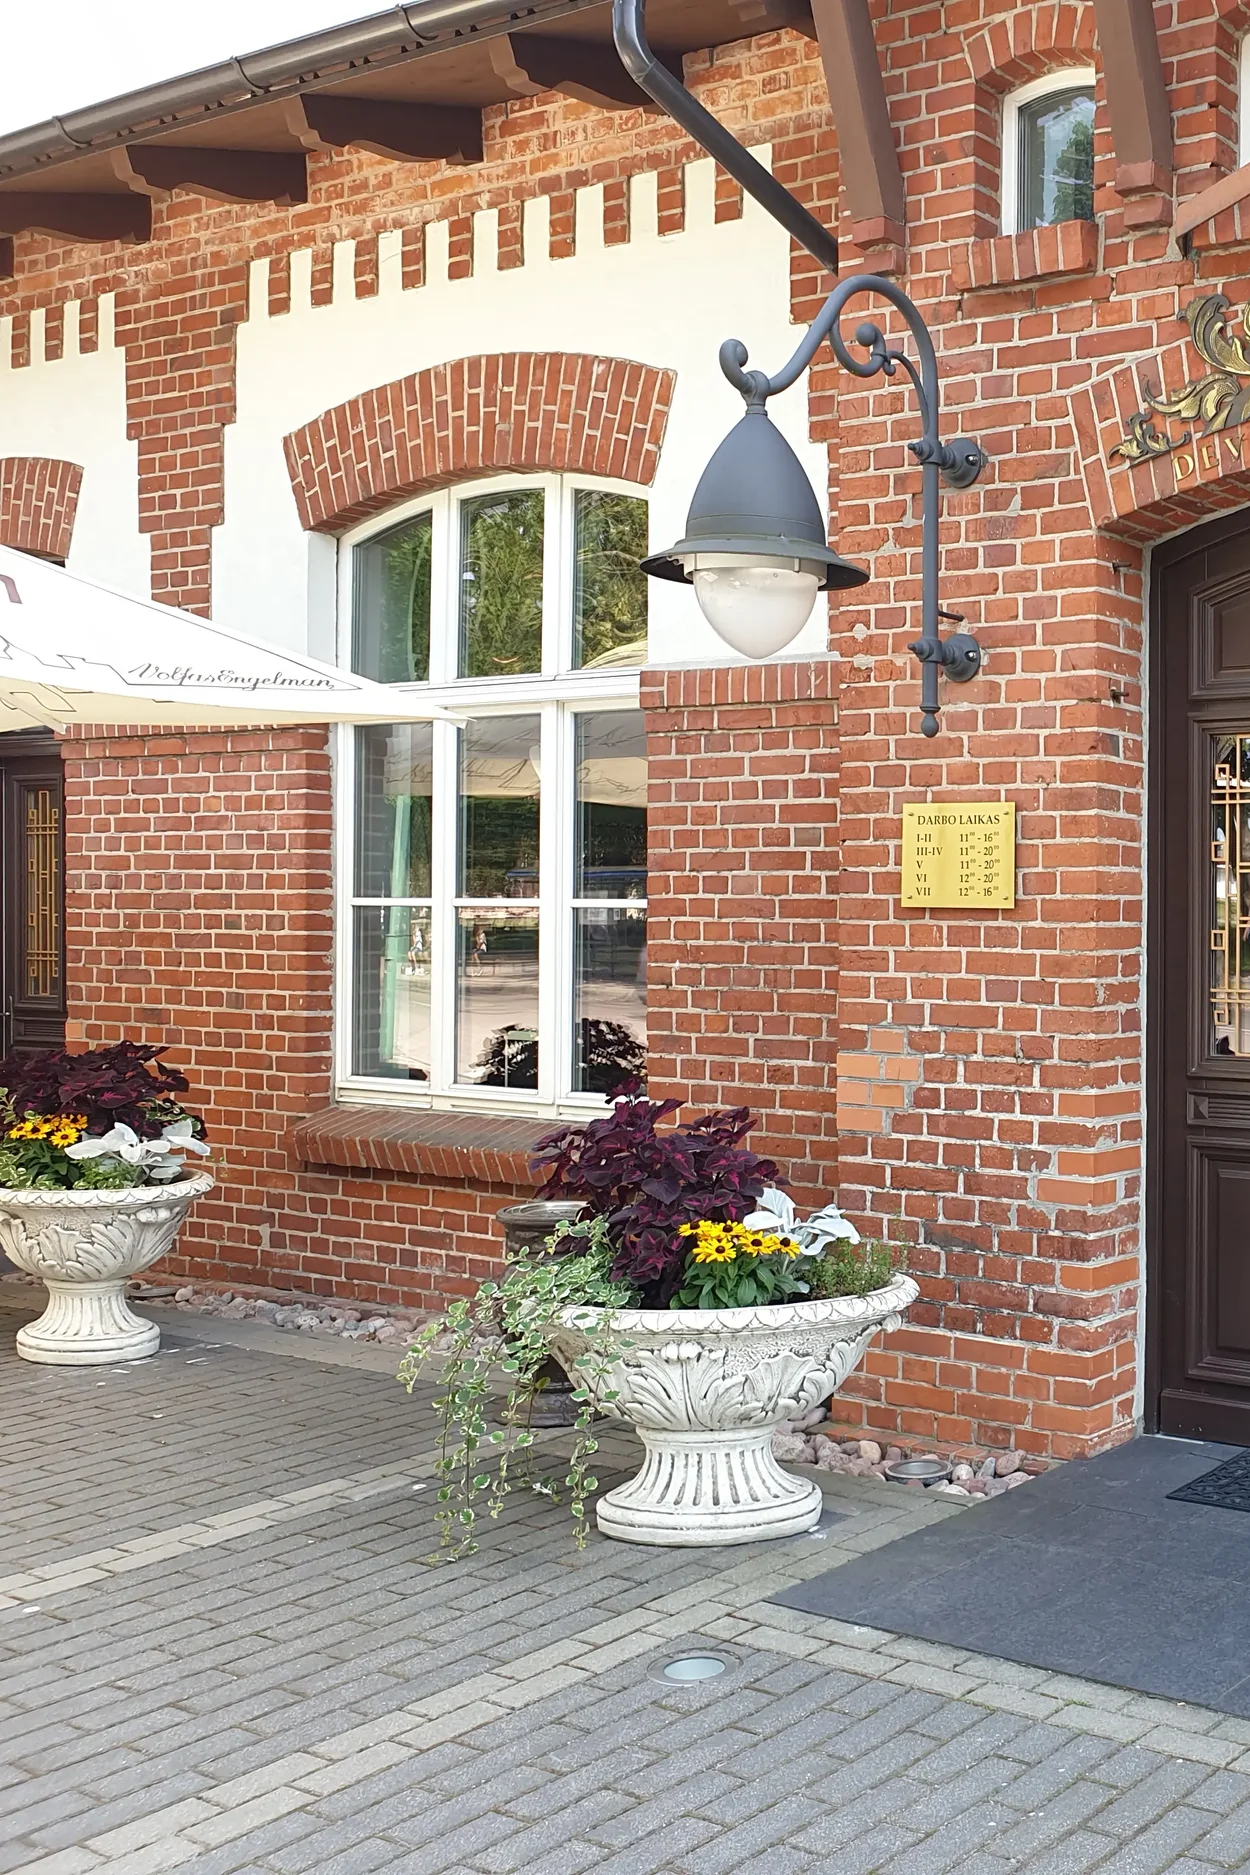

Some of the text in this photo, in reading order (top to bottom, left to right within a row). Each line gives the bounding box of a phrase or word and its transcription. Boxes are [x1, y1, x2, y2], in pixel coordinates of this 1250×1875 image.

[918, 814, 1000, 825] DARBO LAIKAS
[916, 834, 932, 842] I-II
[916, 847, 943, 856] III-IV
[916, 860, 924, 869] V
[916, 874, 927, 882] VI
[916, 887, 931, 896] VII
